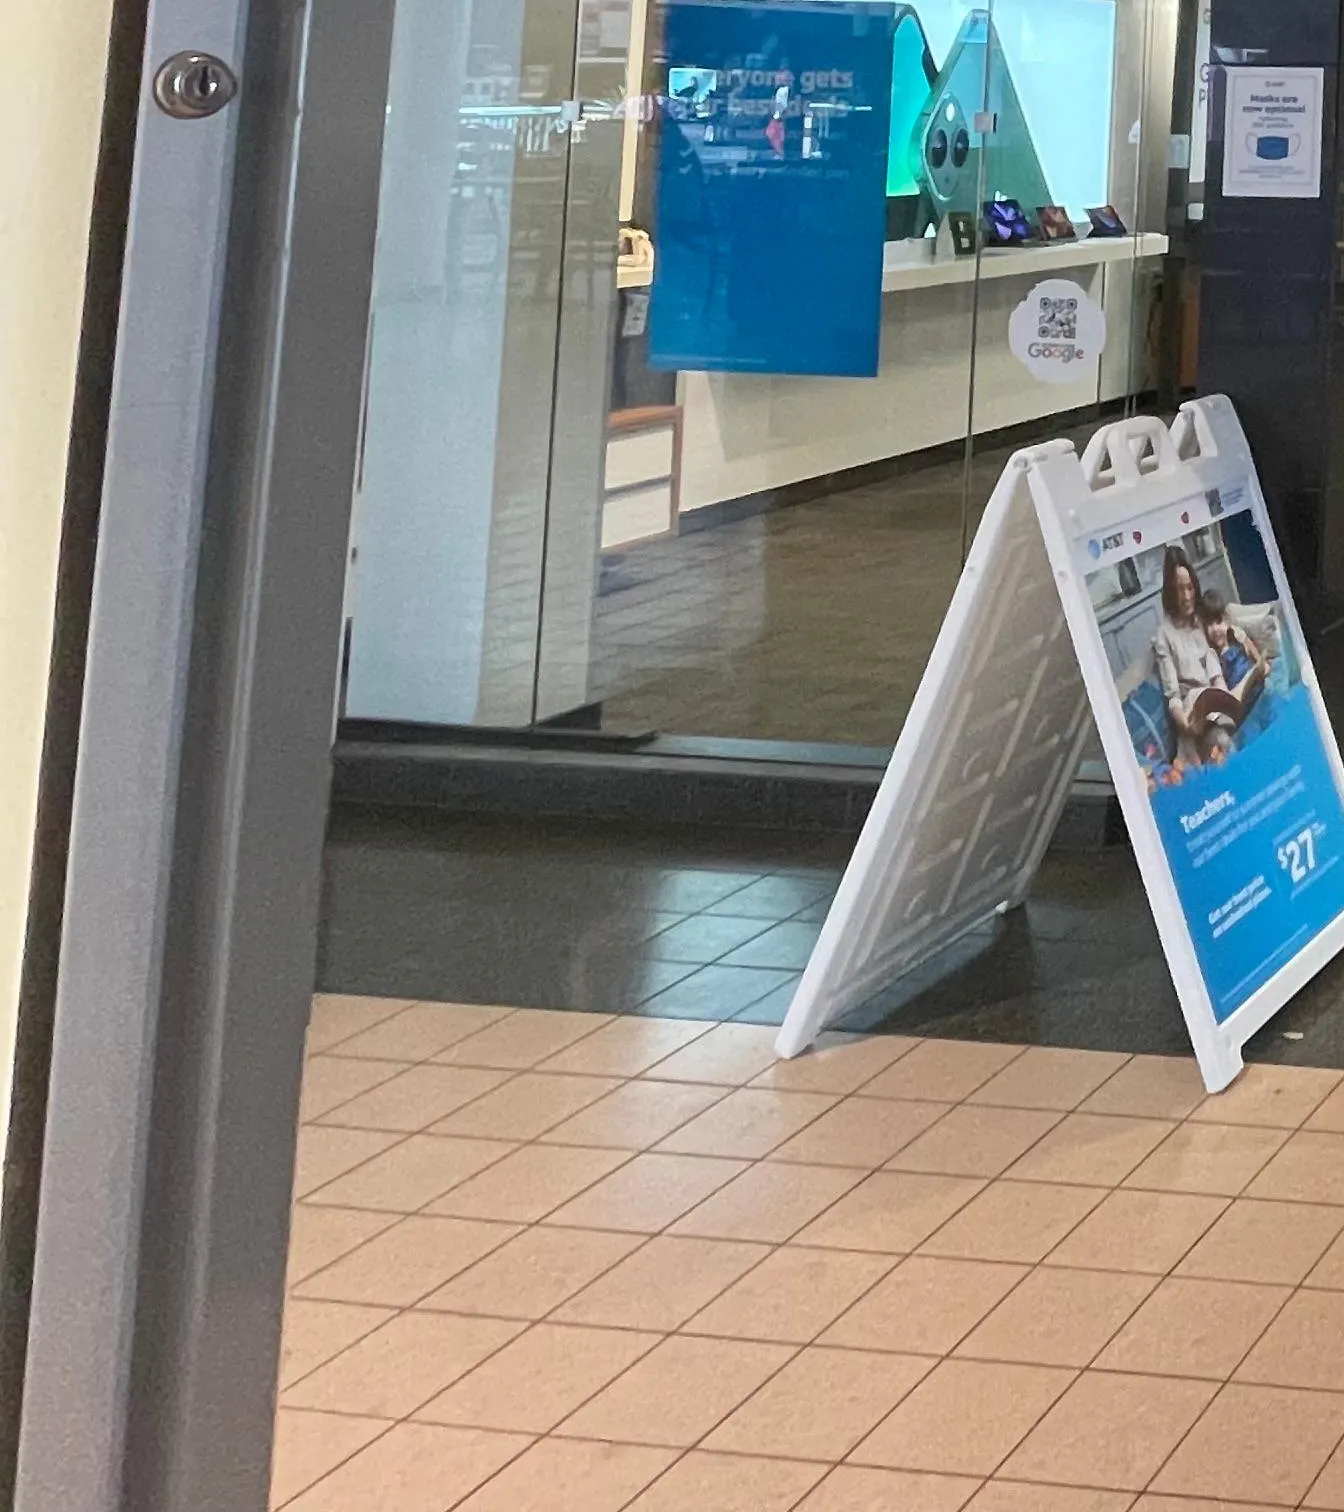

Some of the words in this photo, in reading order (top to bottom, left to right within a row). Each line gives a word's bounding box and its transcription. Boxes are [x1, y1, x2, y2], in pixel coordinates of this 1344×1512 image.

[708, 69, 795, 95] eryone
[800, 68, 853, 94] gets
[1028, 342, 1085, 364] Google
[1180, 790, 1236, 834] Teachers,
[1277, 828, 1316, 884] $27
